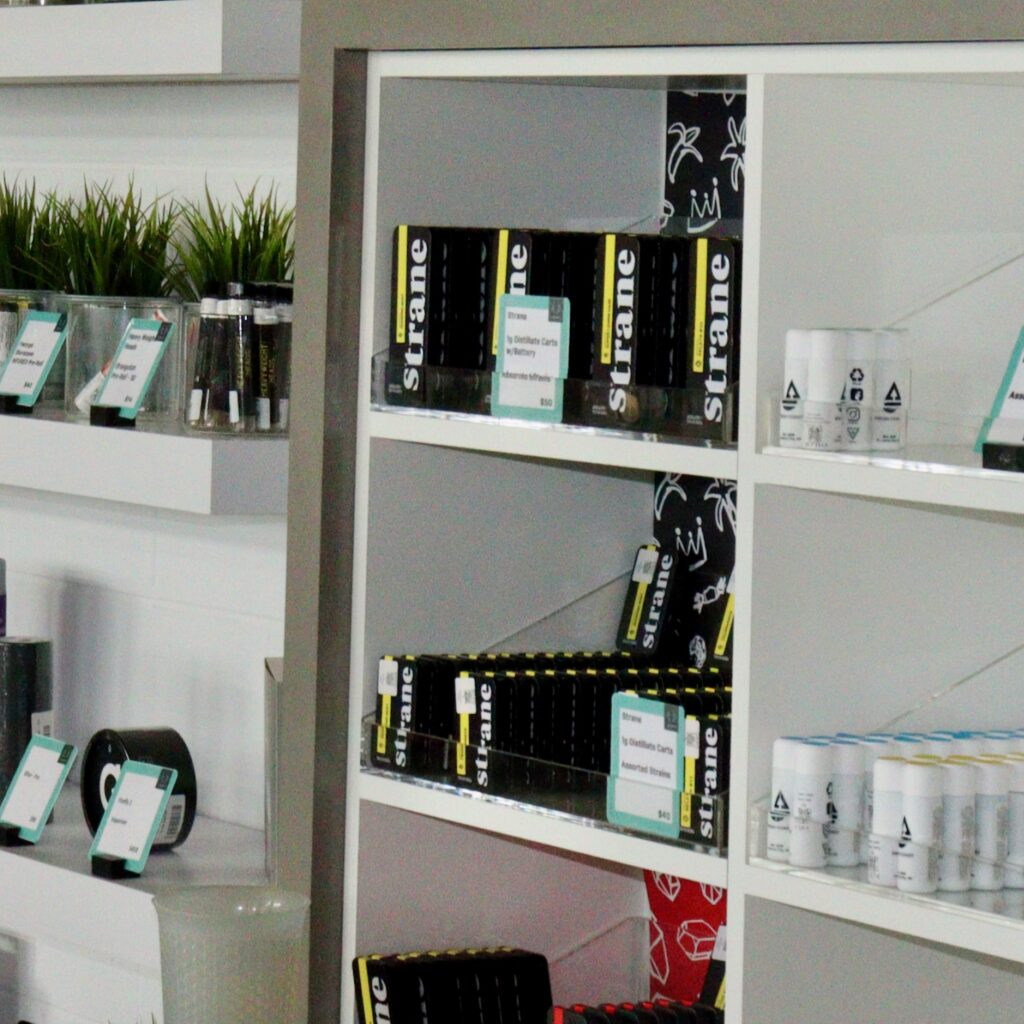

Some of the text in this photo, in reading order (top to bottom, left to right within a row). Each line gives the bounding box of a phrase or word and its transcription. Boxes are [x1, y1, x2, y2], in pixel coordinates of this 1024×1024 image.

[403, 238, 429, 391] strane
[609, 249, 636, 414] strane
[704, 253, 730, 424] strane
[643, 554, 673, 649] strane
[395, 666, 414, 769] strane
[476, 682, 494, 787] strane
[700, 727, 718, 839] strane
